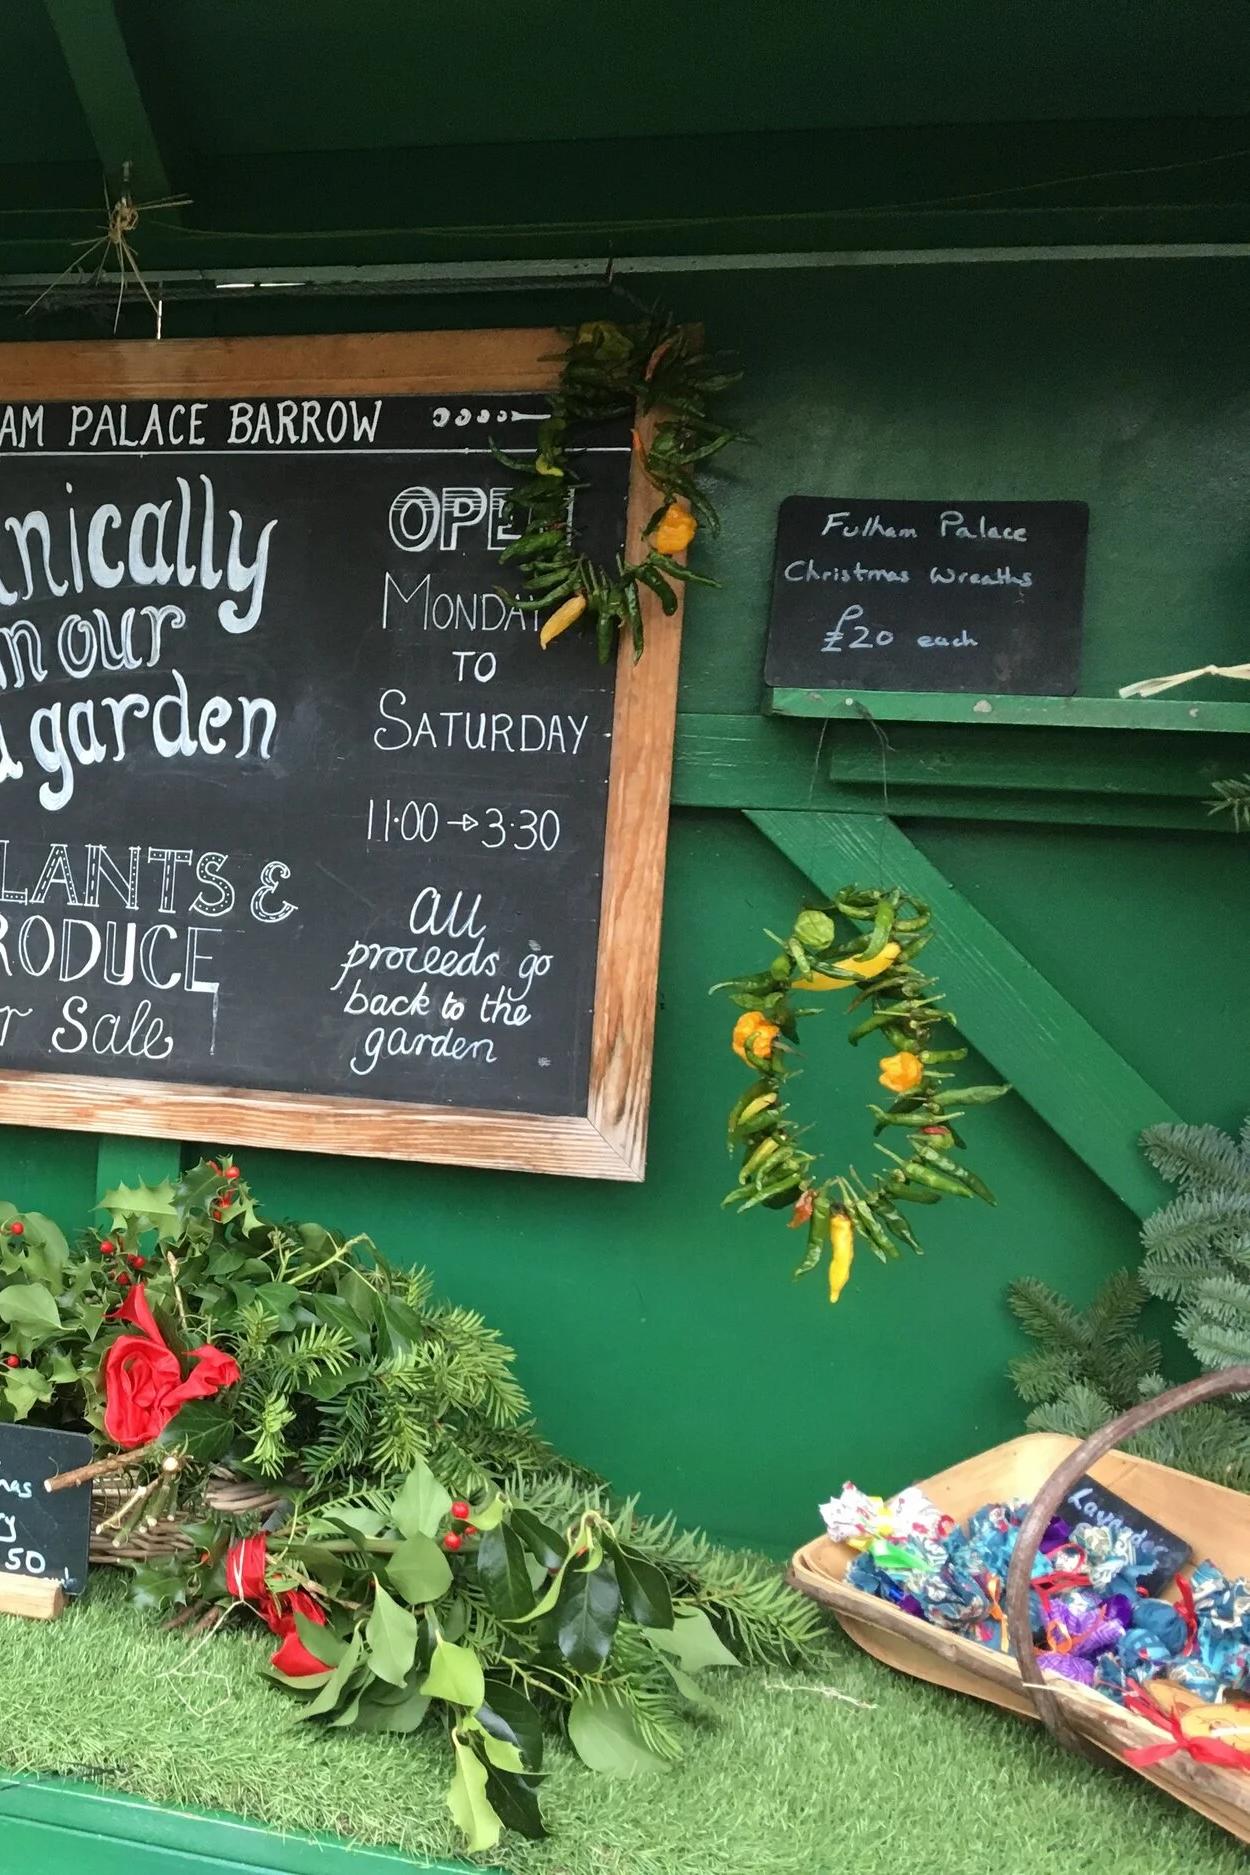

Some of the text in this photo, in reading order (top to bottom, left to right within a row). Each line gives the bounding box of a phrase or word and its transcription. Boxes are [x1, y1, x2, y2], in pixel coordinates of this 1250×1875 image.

[68, 403, 208, 447] PALACE
[227, 400, 383, 444] BARROW
[389, 486, 574, 552] OPE
[821, 510, 1028, 542] Fulham Palace
[784, 558, 911, 583] Christmas
[57, 604, 186, 679] our
[820, 604, 979, 652] £20 each
[452, 651, 497, 683] TO
[30, 669, 278, 811] garden
[373, 689, 589, 754] SATURDAY
[250, 860, 299, 923] &
[330, 937, 554, 1001] proceeds go
[51, 995, 175, 1060] Sale
[343, 978, 532, 1027] back to the
[350, 1026, 498, 1076] garden
